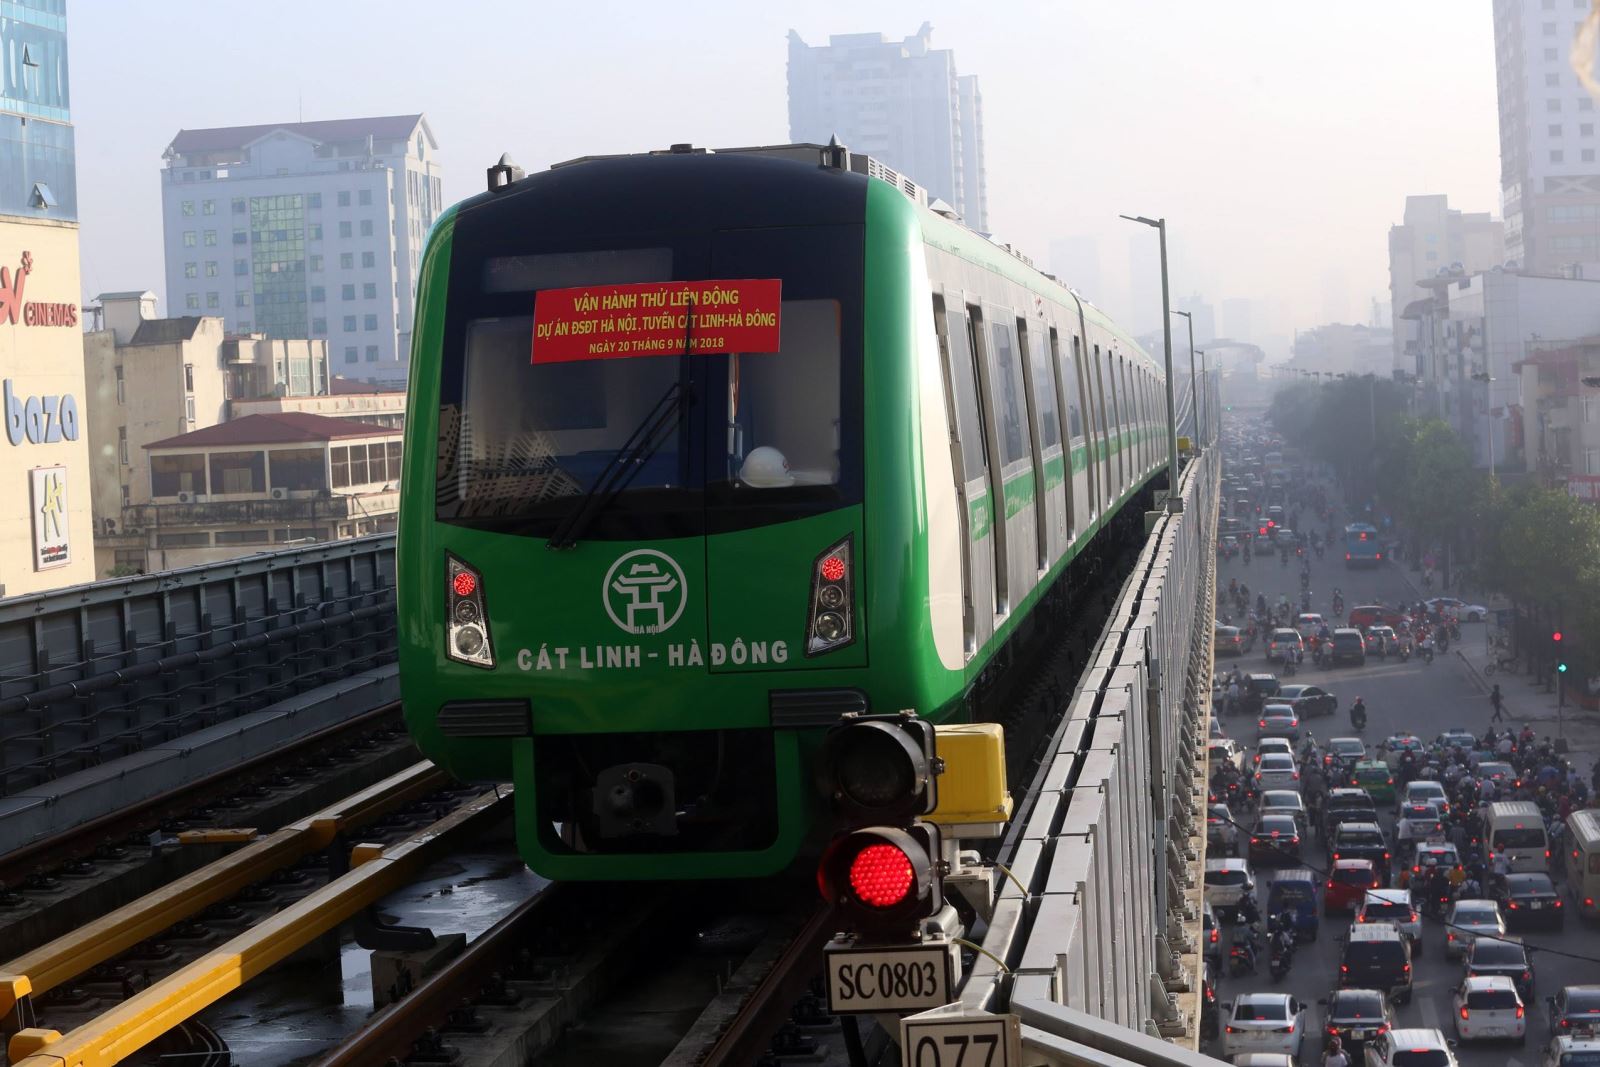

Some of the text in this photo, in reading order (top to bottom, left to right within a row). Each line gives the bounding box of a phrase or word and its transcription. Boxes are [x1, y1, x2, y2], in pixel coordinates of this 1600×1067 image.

[24, 302, 77, 327] CINEMAS
[574, 285, 739, 315] VẬN HÀNH THỬ LIÊN ĐỘNG
[537, 320, 554, 340] DỰ
[554, 318, 569, 336] ÁN
[571, 320, 599, 335] ĐSĐT
[600, 314, 615, 333] HÀ
[678, 310, 698, 329] CT
[745, 308, 776, 326] ĐÔNG
[589, 336, 724, 354] NGÀY 20 THÁNG 9 NM 2018
[3, 379, 79, 446] baza
[517, 643, 569, 671] CÁT
[580, 645, 641, 669] LINH
[668, 638, 704, 667] HÀ
[710, 637, 788, 665] ĐÔNG
